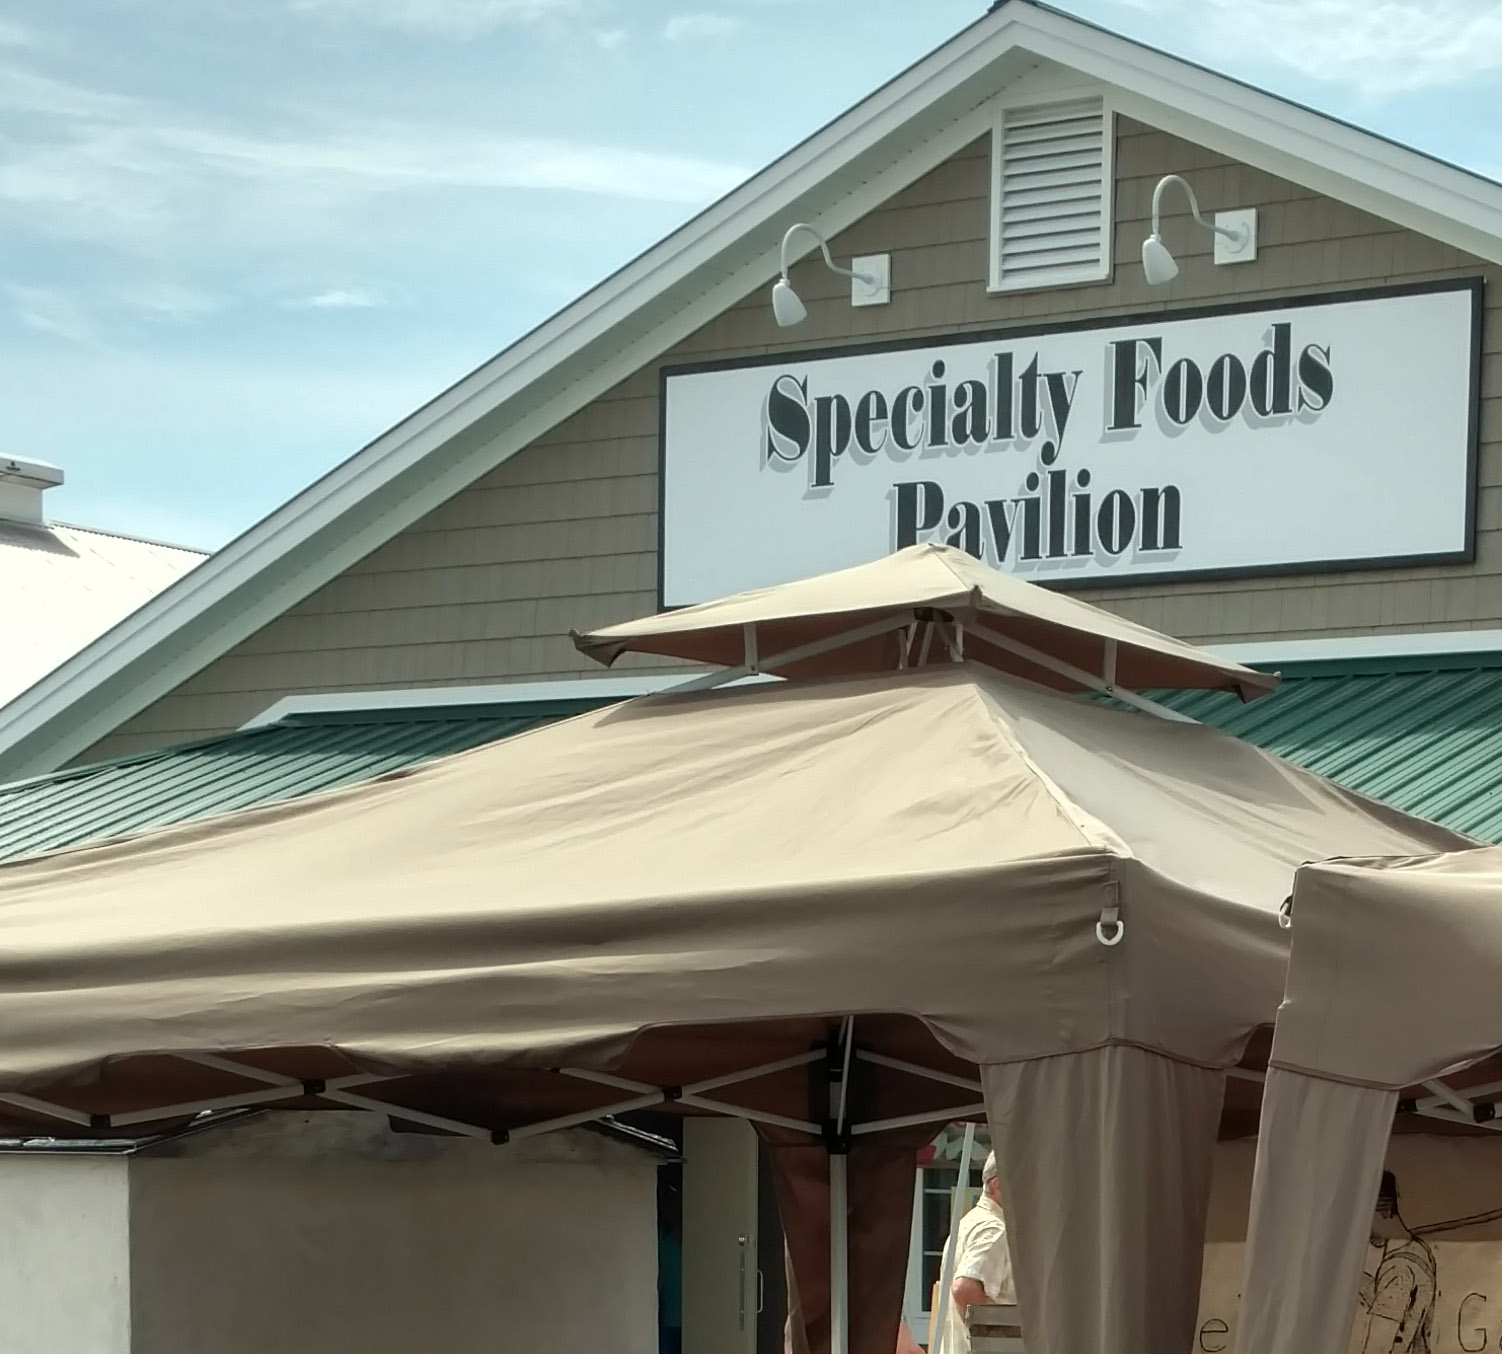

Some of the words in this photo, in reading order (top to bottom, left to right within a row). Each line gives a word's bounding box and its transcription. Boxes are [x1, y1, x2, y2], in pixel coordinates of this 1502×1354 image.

[767, 351, 1083, 488] Specialty
[1107, 322, 1334, 431] Foods
[892, 468, 1183, 562] Pavilion
